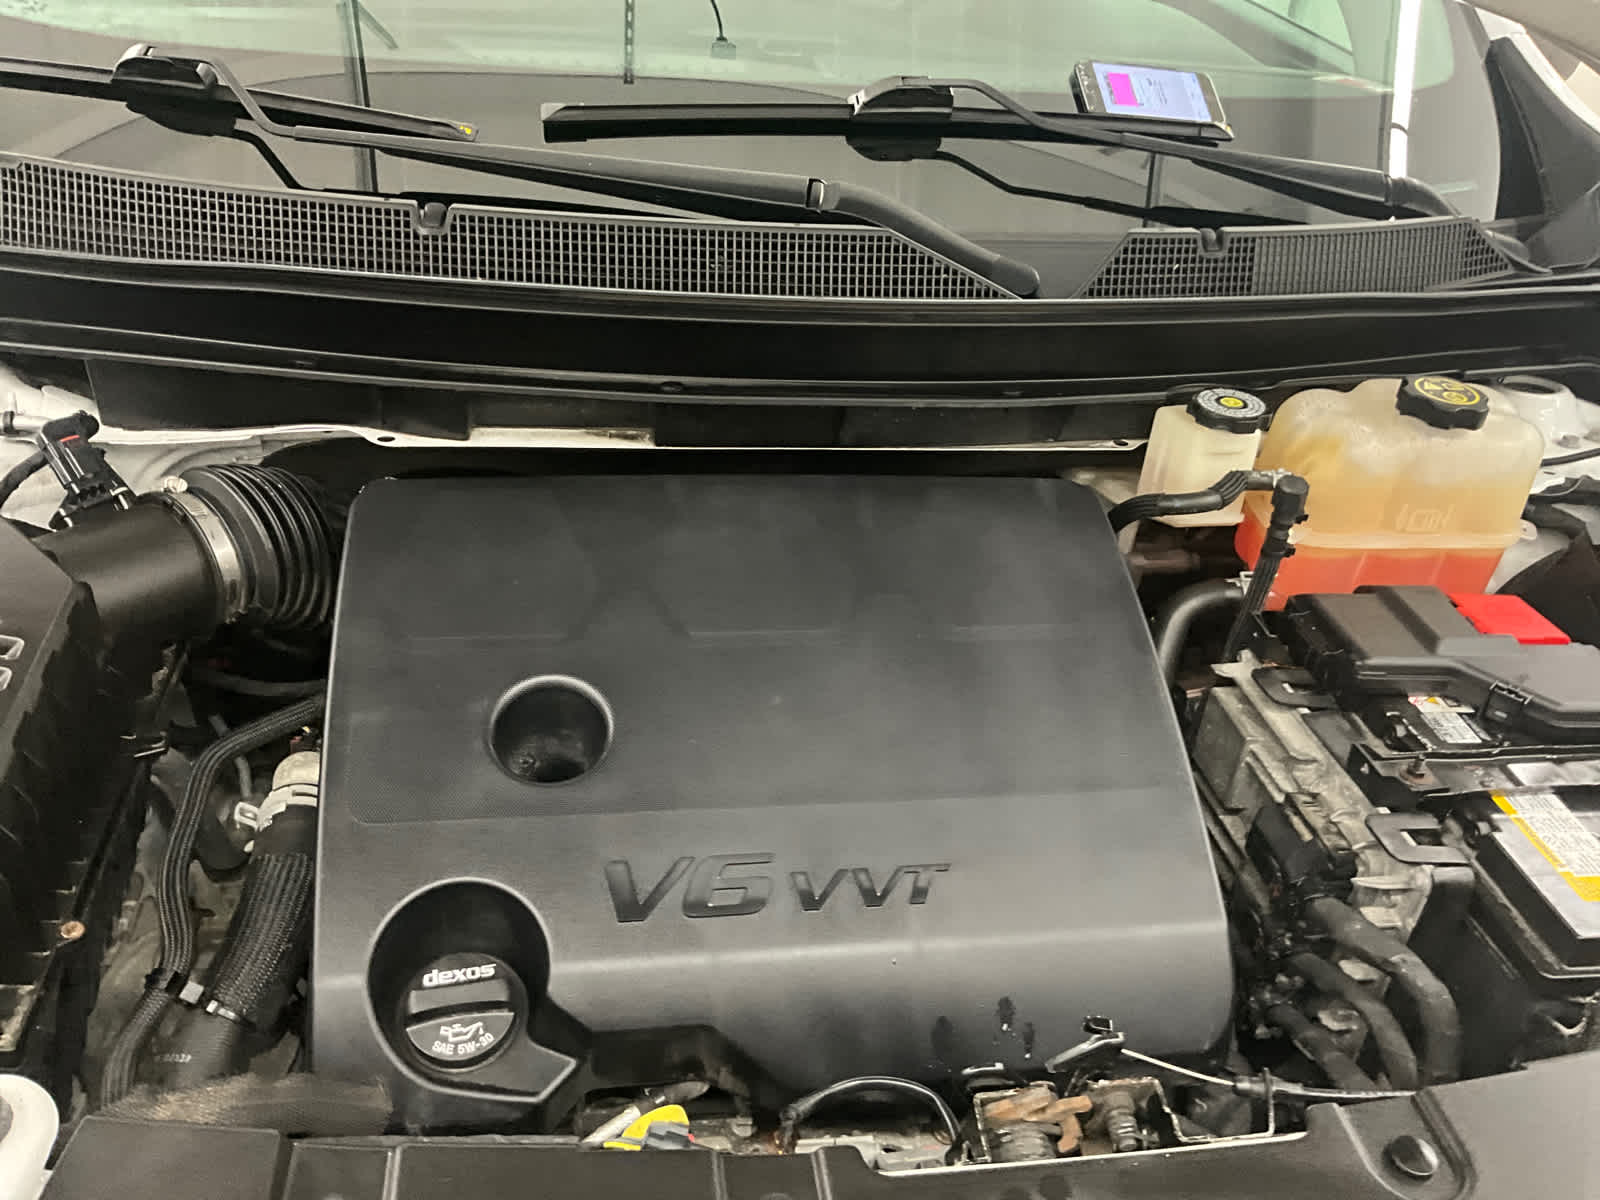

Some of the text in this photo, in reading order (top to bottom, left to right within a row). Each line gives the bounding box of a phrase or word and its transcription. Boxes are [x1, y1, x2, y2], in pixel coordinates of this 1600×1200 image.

[604, 852, 952, 923] V6 VVT
[422, 963, 497, 988] dexos
[431, 1032, 495, 1055] SAE 5W-30
